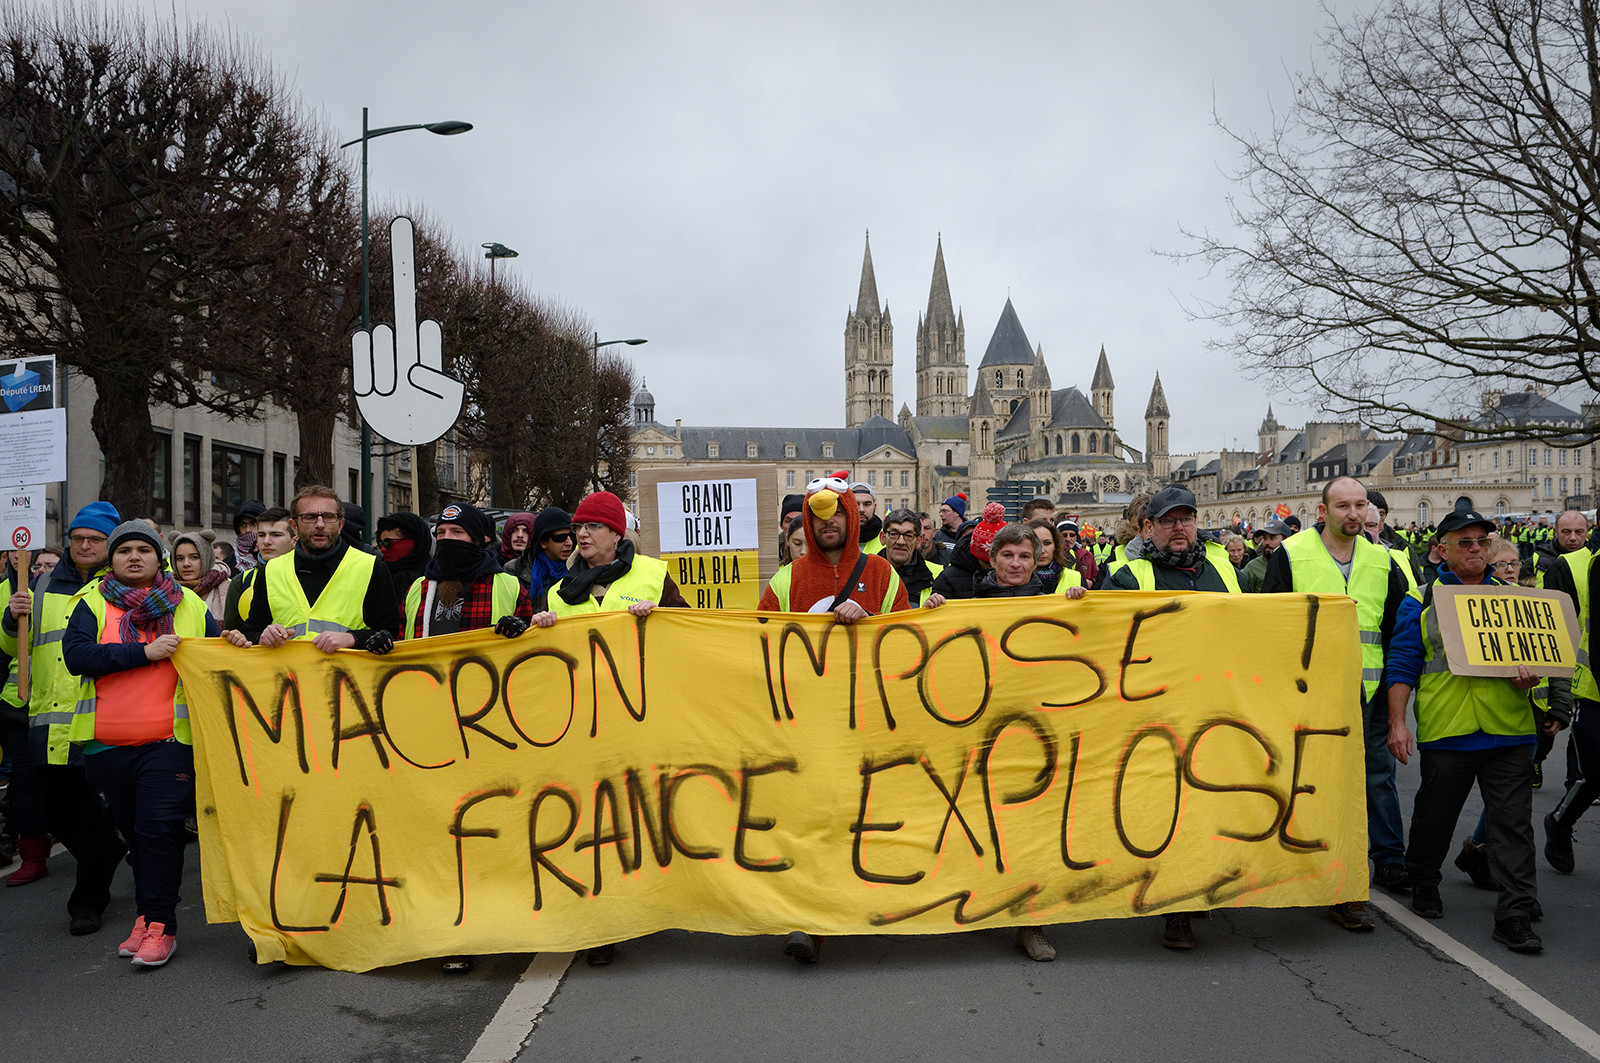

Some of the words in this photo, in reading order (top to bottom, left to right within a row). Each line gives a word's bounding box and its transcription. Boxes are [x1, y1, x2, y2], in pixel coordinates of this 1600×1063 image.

[0, 385, 28, 397] Député
[29, 384, 51, 394] LREM
[12, 496, 31, 506] NON
[682, 483, 733, 513] GRAND
[16, 533, 28, 542] 80
[685, 511, 732, 546] DÉBAT
[679, 556, 707, 585] BLA
[712, 555, 741, 584] BLA
[1467, 598, 1557, 630] CASTANER
[1478, 632, 1504, 662] EN
[1506, 631, 1562, 663] ENFER
[210, 617, 648, 797] MACRON
[270, 785, 405, 936] LA
[449, 757, 799, 928] FRANCE
[849, 710, 1351, 887] EXPLOSE
